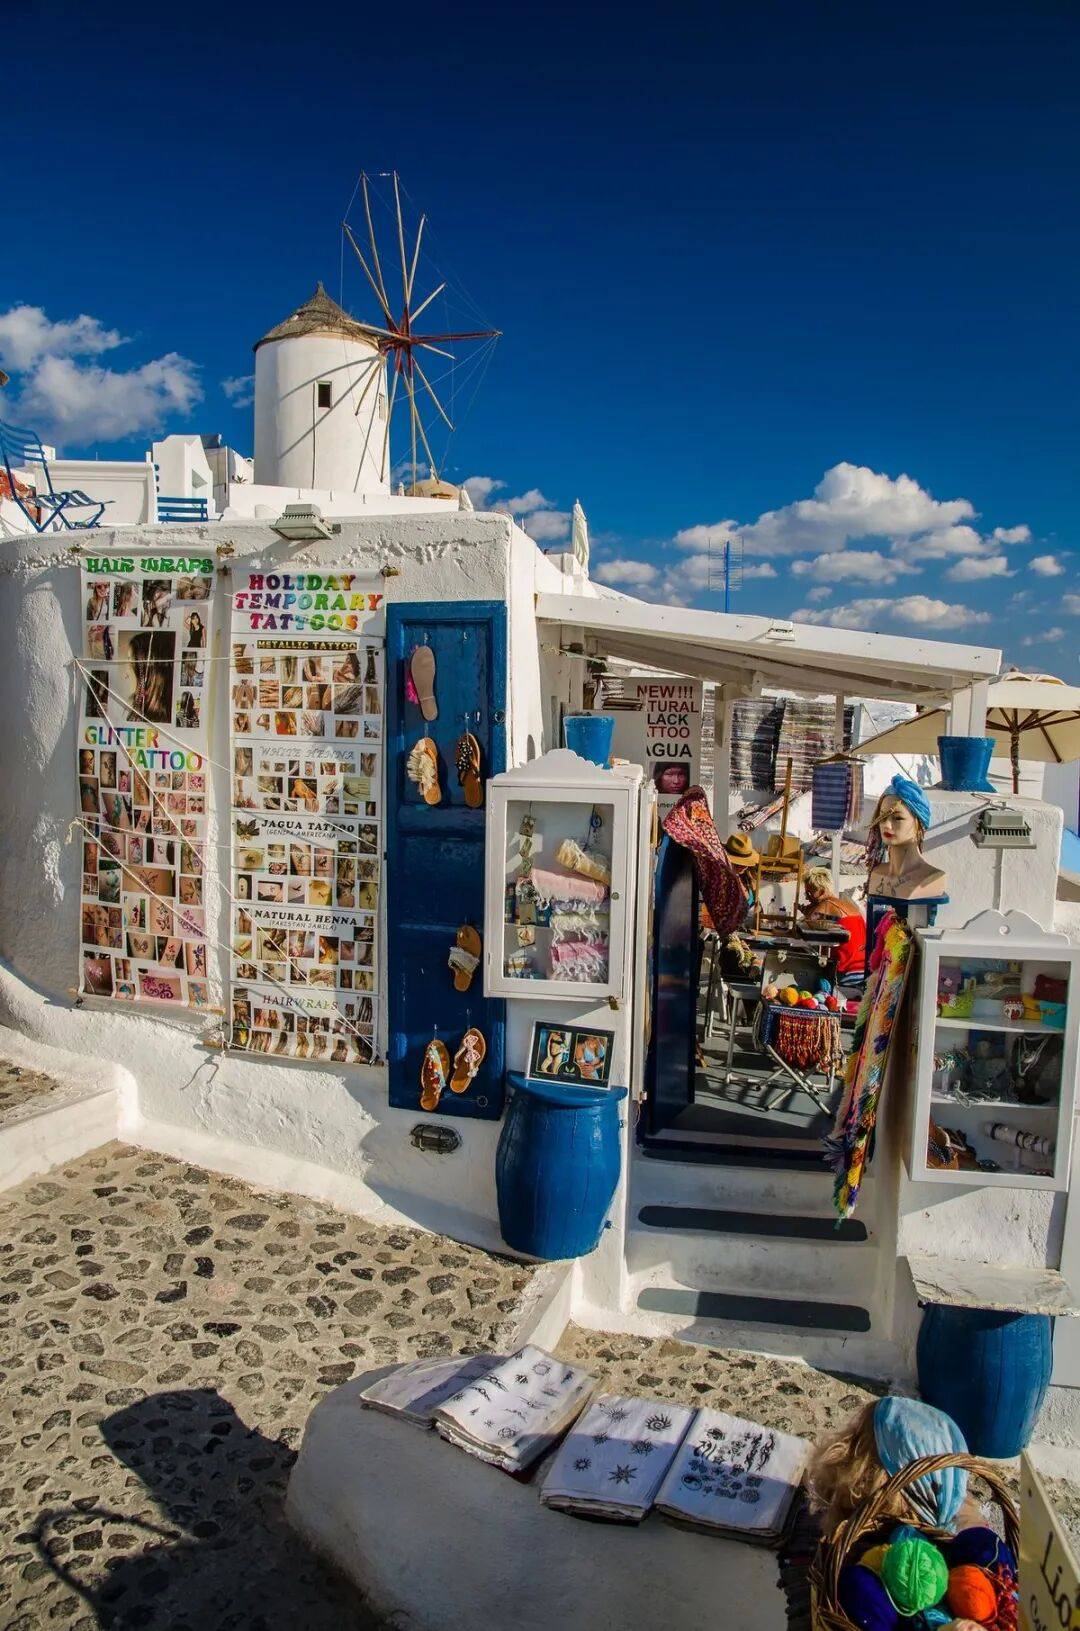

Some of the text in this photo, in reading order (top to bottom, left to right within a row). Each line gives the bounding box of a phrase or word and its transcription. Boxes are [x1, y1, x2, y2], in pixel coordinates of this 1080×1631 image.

[85, 557, 214, 574] HAIR WRAPS
[249, 574, 356, 591] HOLIDAY
[235, 592, 383, 611] TEMPORARY
[250, 612, 359, 631] TATTOOS
[257, 640, 357, 650] METALLIC TATTOO
[647, 700, 699, 713] TURAL
[647, 713, 689, 726] LACK
[85, 725, 159, 748] GLITTER
[647, 725, 690, 738] TTOO
[126, 748, 203, 772] TATTOO
[262, 819, 355, 833] JAGUA TATTOO
[255, 910, 357, 926] NATURAL HENNA
